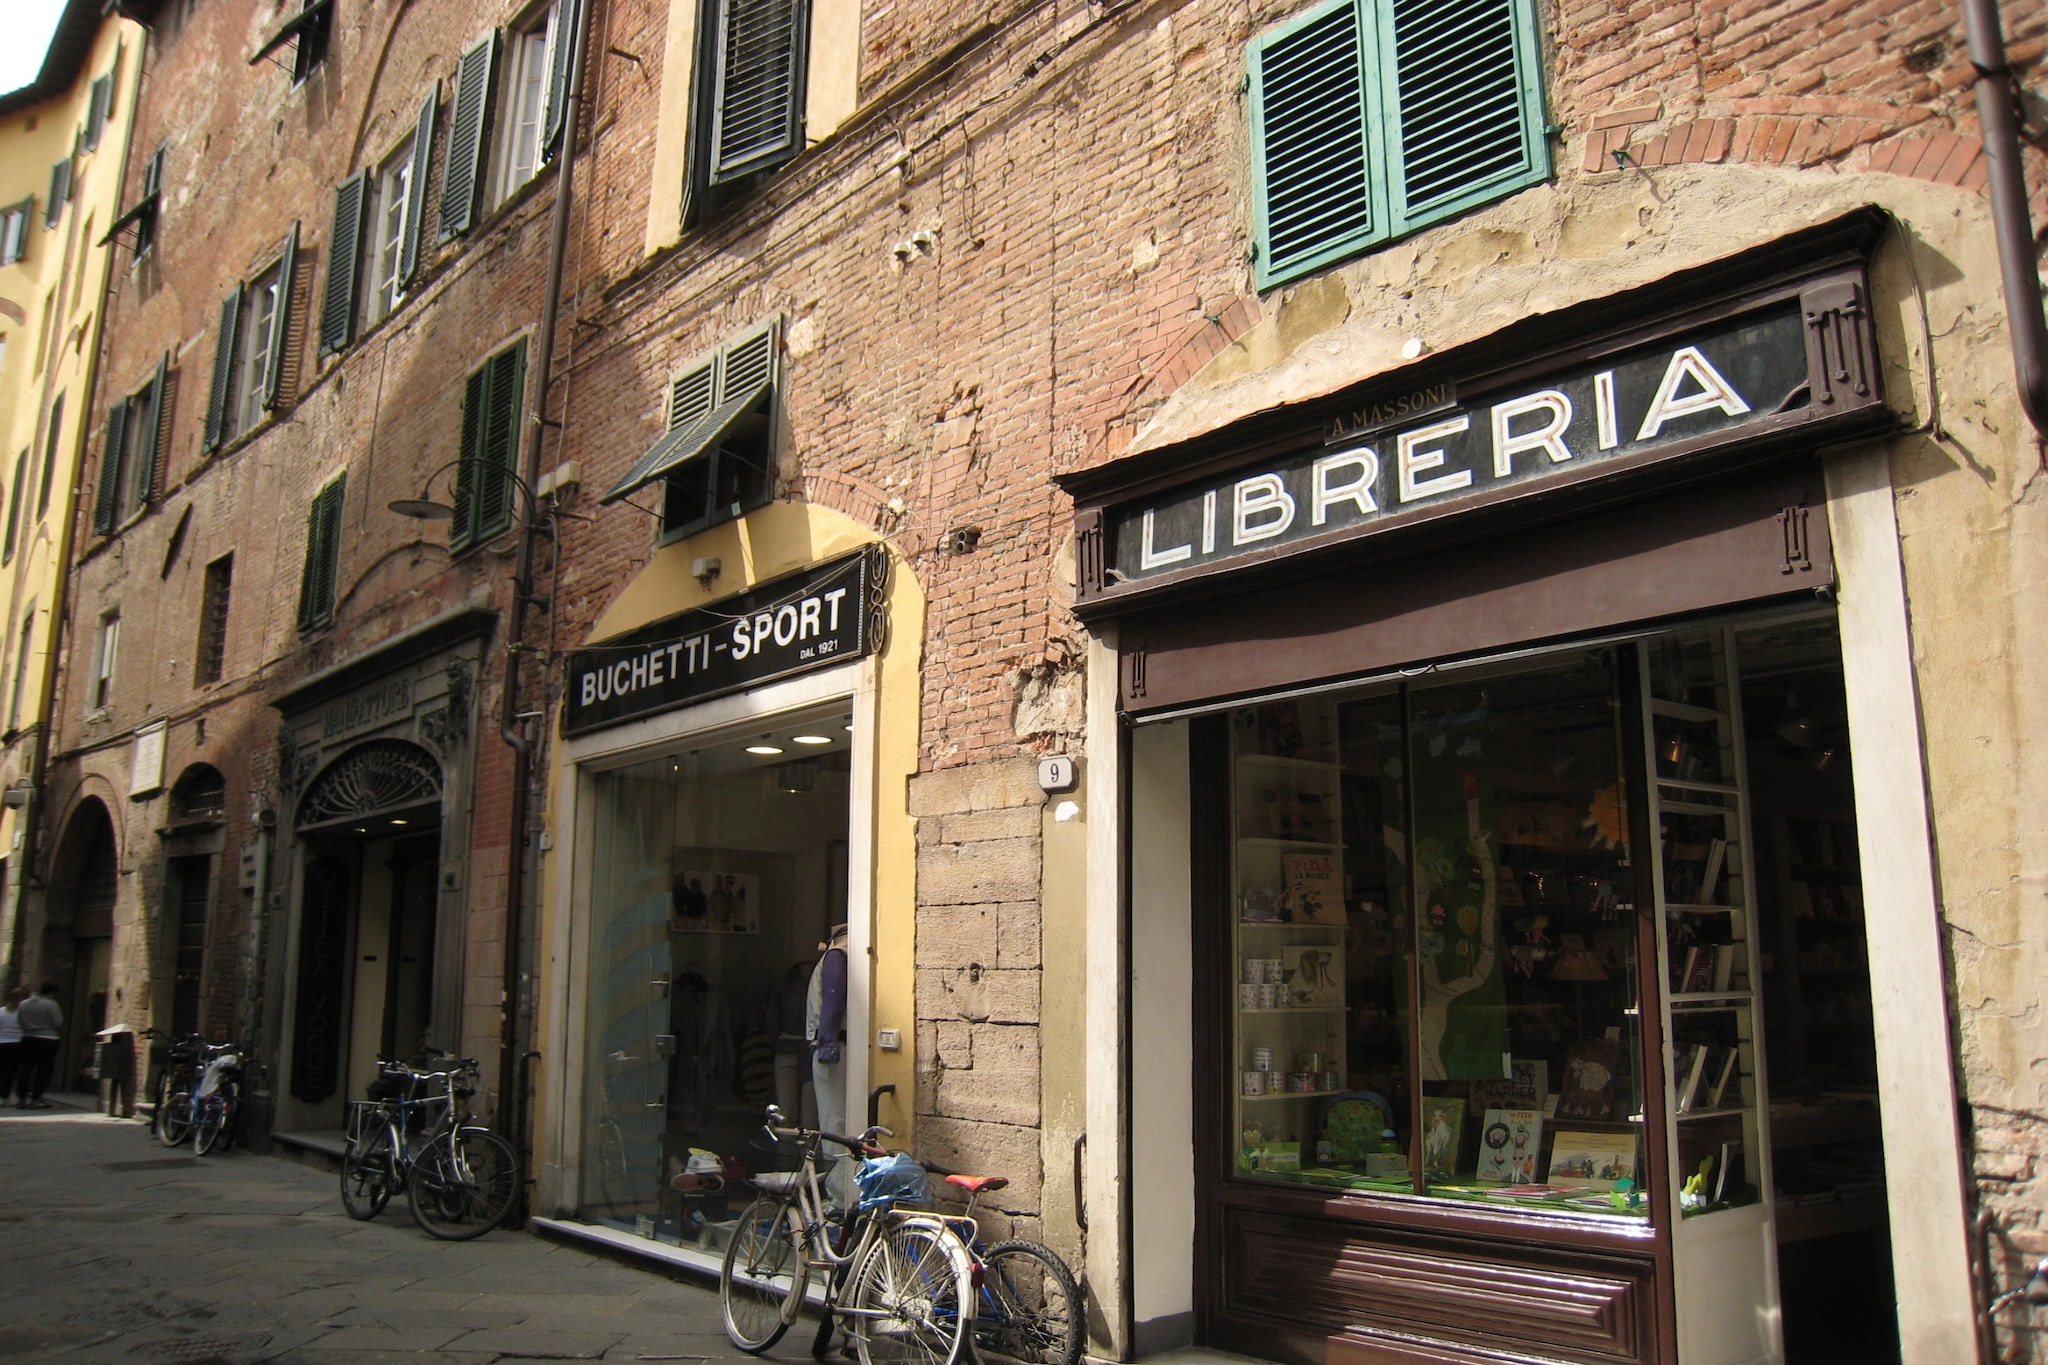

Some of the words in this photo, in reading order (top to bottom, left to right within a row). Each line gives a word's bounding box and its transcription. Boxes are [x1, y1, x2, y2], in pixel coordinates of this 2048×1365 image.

[1332, 417, 1349, 437] A.
[1351, 384, 1447, 430] MASSONI
[1140, 345, 1752, 571] LIBRERIA
[800, 647, 815, 660] DAL
[818, 639, 838, 655] 1921
[1050, 763, 1059, 783] 9
[312, 869, 336, 976] OTTICA
[306, 995, 329, 1089] VOGUE
